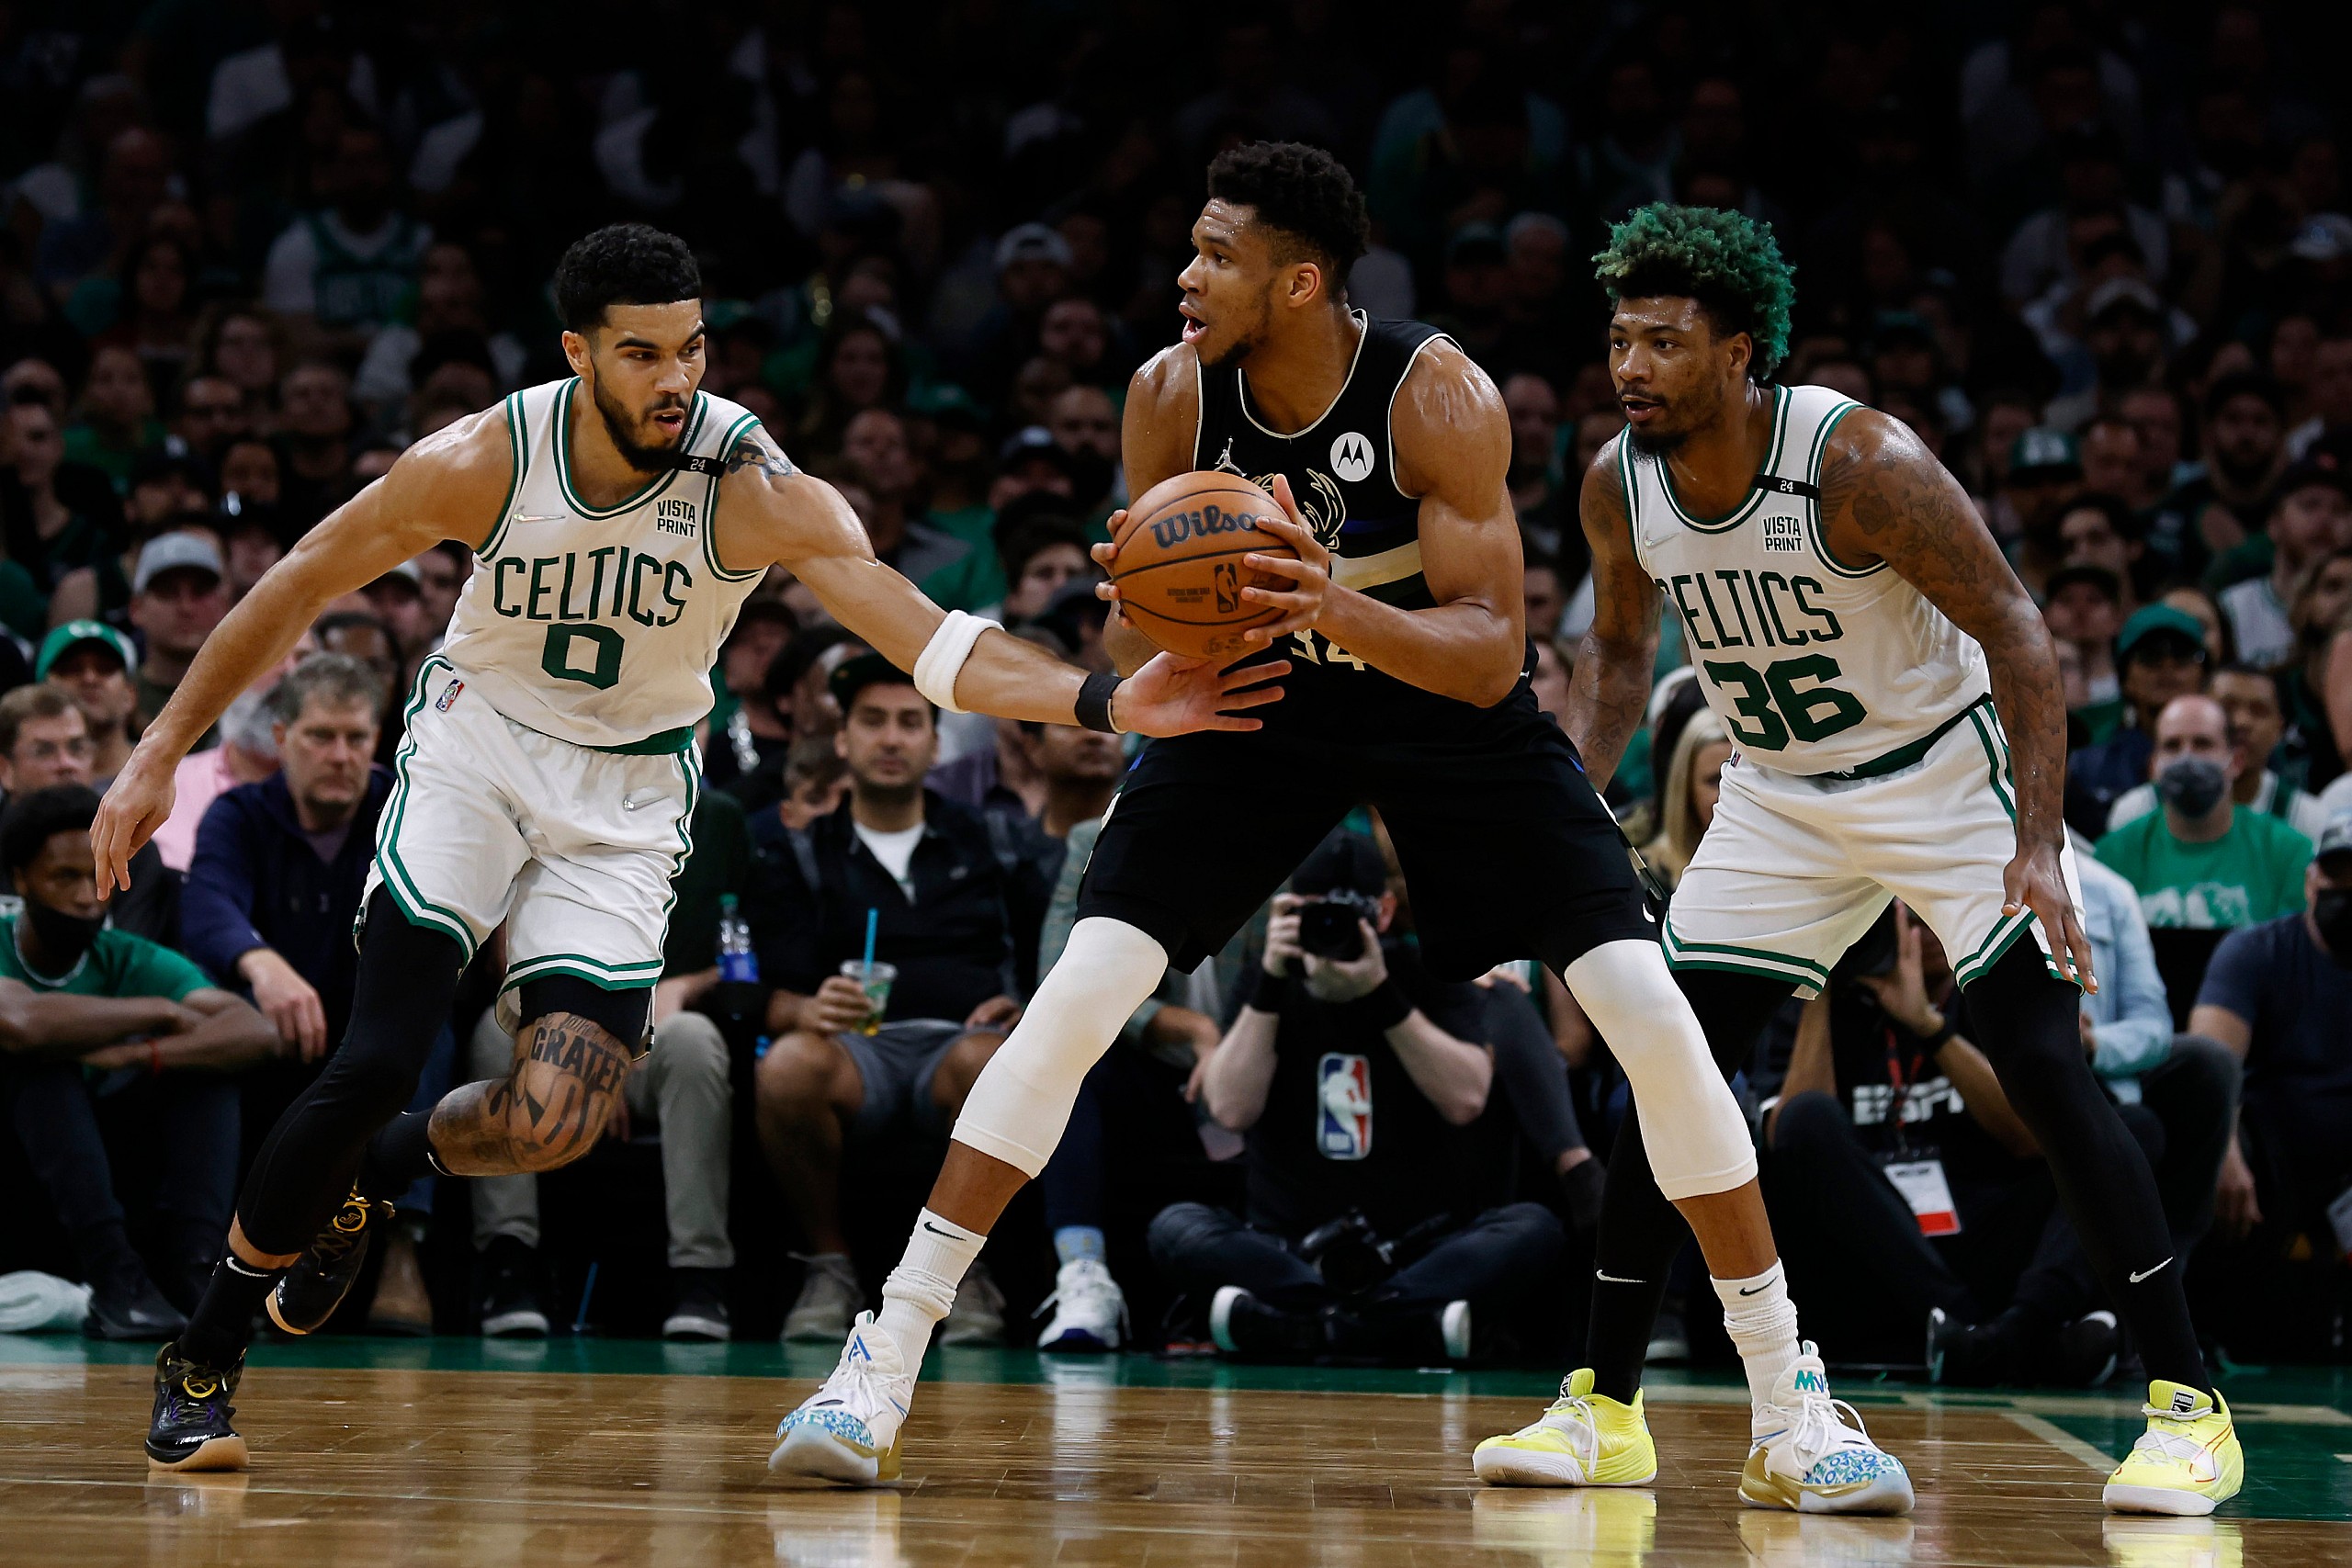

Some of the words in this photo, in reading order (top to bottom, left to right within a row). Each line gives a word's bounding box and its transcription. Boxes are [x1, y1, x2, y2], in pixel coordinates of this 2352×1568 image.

[690, 459, 707, 470] 24
[1780, 480, 1794, 492] 24
[657, 500, 695, 522] VISTA
[657, 518, 695, 537] PRINT
[1151, 504, 1260, 548] Wilso
[1763, 516, 1801, 536] VISTA
[1765, 537, 1802, 551] PRINT
[493, 546, 692, 627] CELTICS
[1655, 569, 1844, 649] ELTICS
[541, 623, 625, 690] 0
[1703, 653, 1867, 751] 36
[1794, 1370, 1828, 1393] MV
